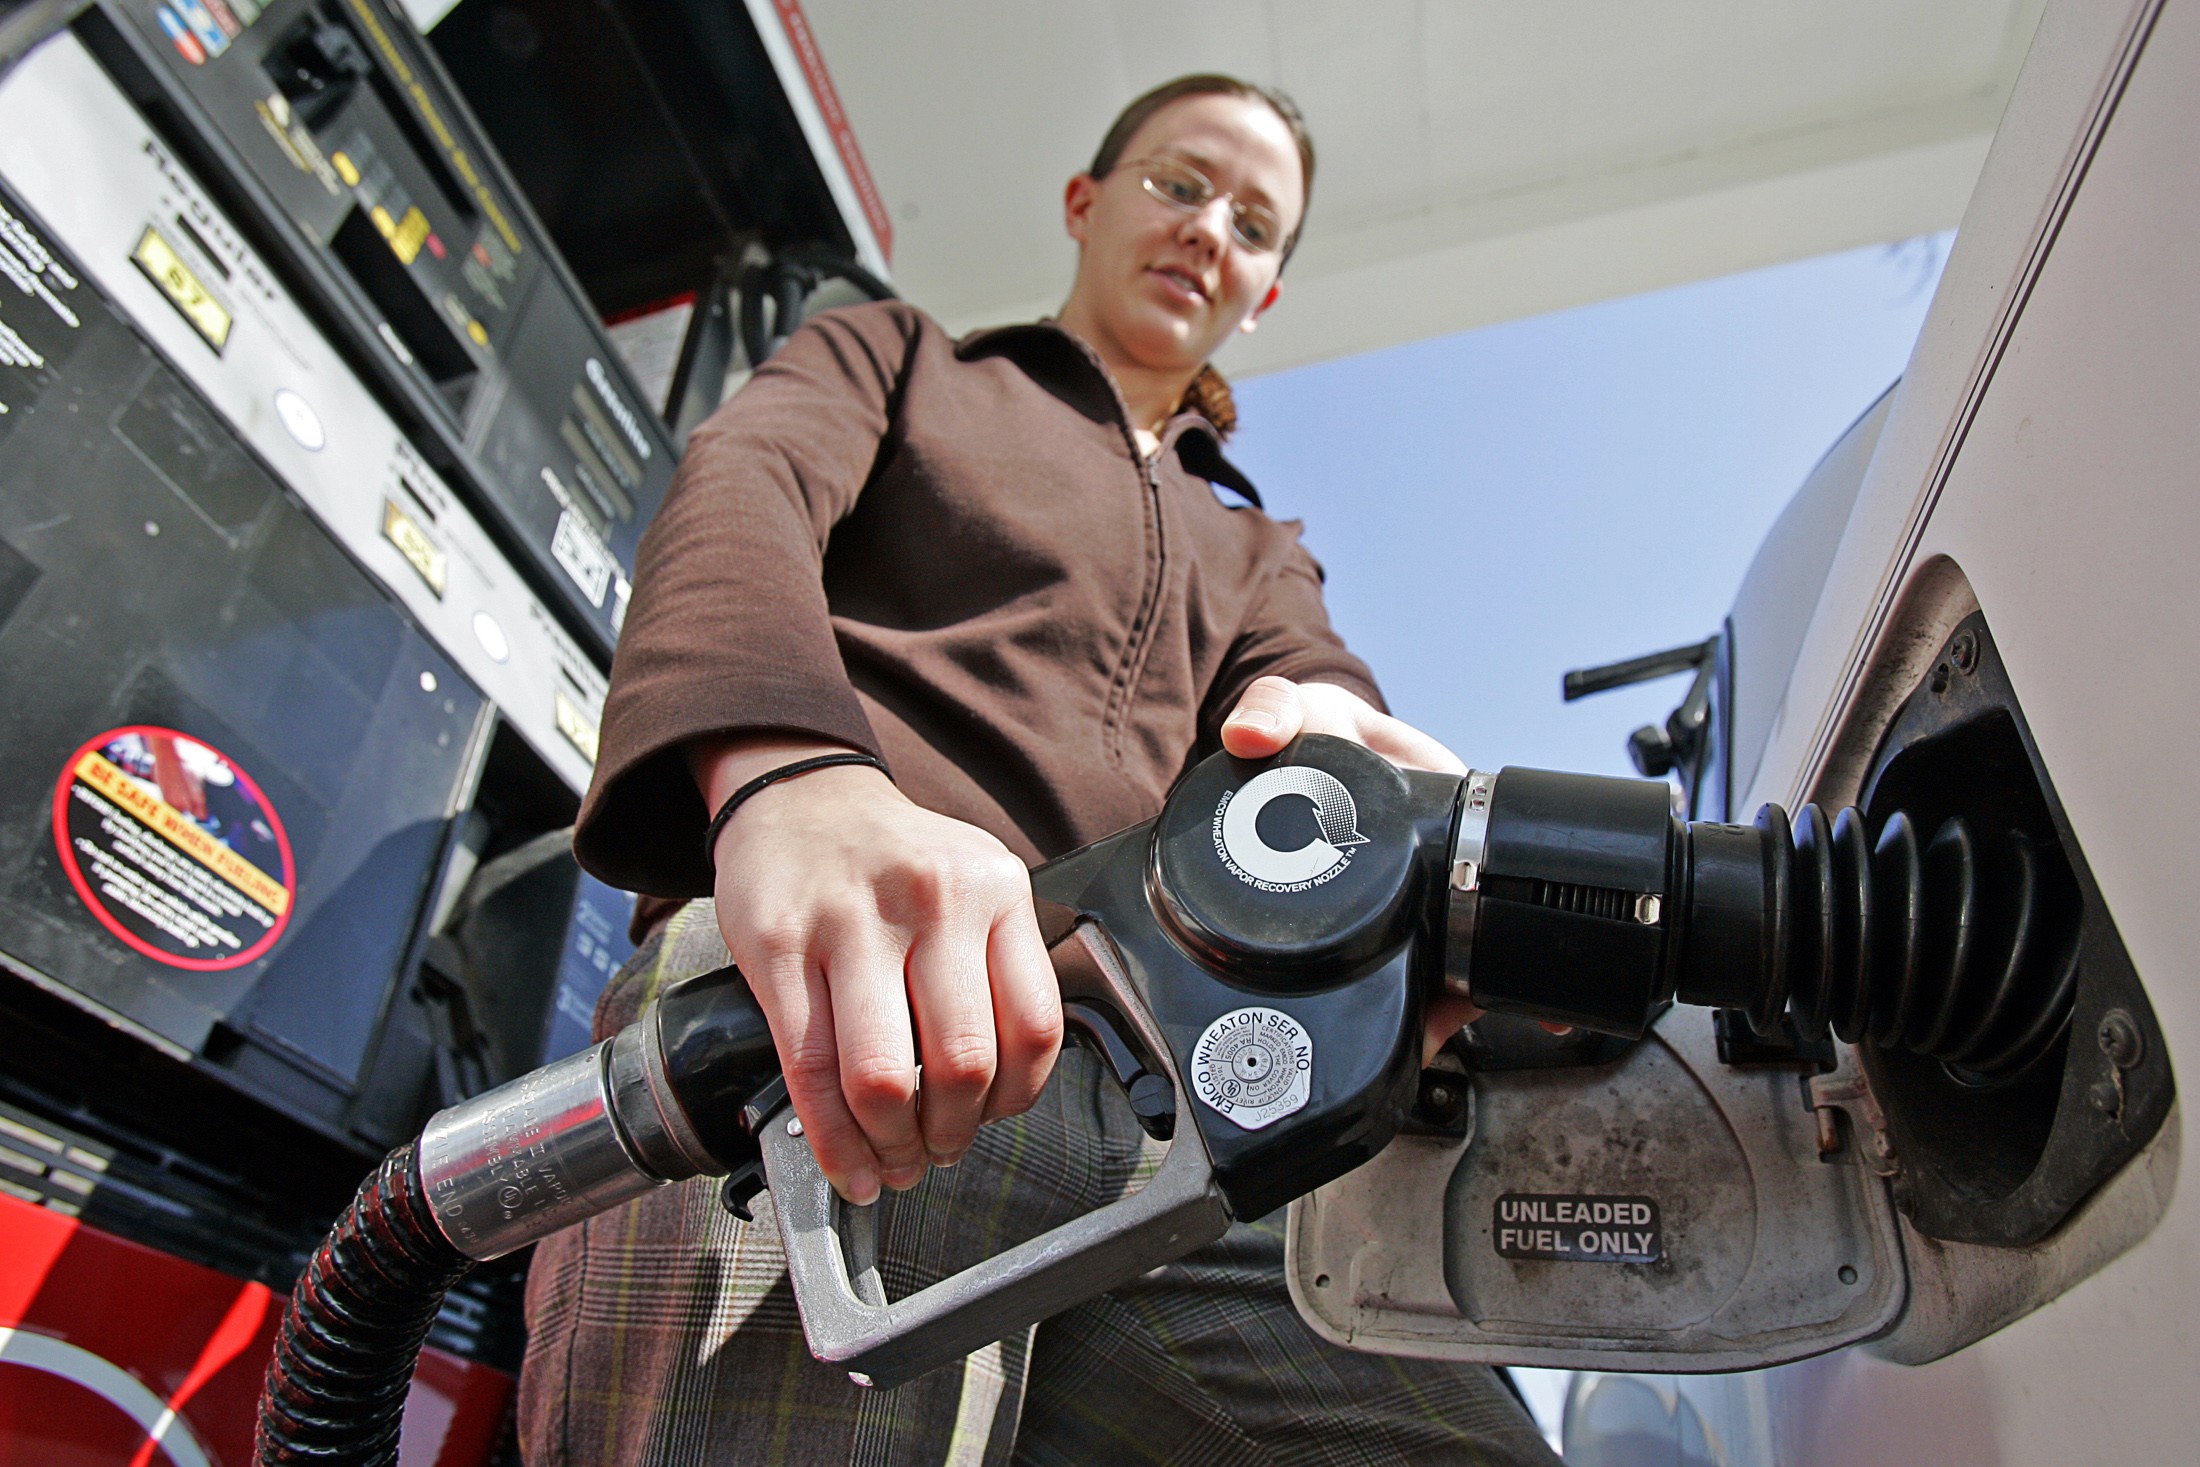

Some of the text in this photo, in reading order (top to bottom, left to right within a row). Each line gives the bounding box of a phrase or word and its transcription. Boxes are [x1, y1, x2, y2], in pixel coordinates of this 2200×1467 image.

[143, 140, 275, 300] Regular
[90, 762, 113, 786] BE
[116, 782, 159, 818] SAFE
[1215, 790, 1233, 816] EMCO
[1212, 816, 1230, 863] WHEATON
[1225, 859, 1254, 886] VAPOR
[1314, 857, 1351, 887] NOZZLE
[1253, 880, 1313, 893] RECOVERY
[1197, 1012, 1263, 1066] WHEATON
[1267, 1014, 1299, 1044] SER.
[1225, 1043, 1239, 1060] 4005
[1257, 1038, 1276, 1052] HOLDS
[1261, 1025, 1295, 1065] CERTIFICATIONS
[1260, 1032, 1288, 1093] MARKED EMCO WHEATON
[1295, 1046, 1310, 1074] NO.
[1208, 1063, 1220, 1086] LISTED
[1262, 1070, 1280, 1087] COVER
[1284, 1067, 1295, 1086] VALID
[1198, 1071, 1235, 1114] EMCO
[1235, 1097, 1255, 1105] RIVET
[1267, 1087, 1283, 1101] ONLY
[1256, 1094, 1299, 1122] J25359
[436, 1177, 463, 1217] END
[1501, 1201, 1651, 1225] UNLEADED
[1501, 1229, 1653, 1255] FUEL ONLY
